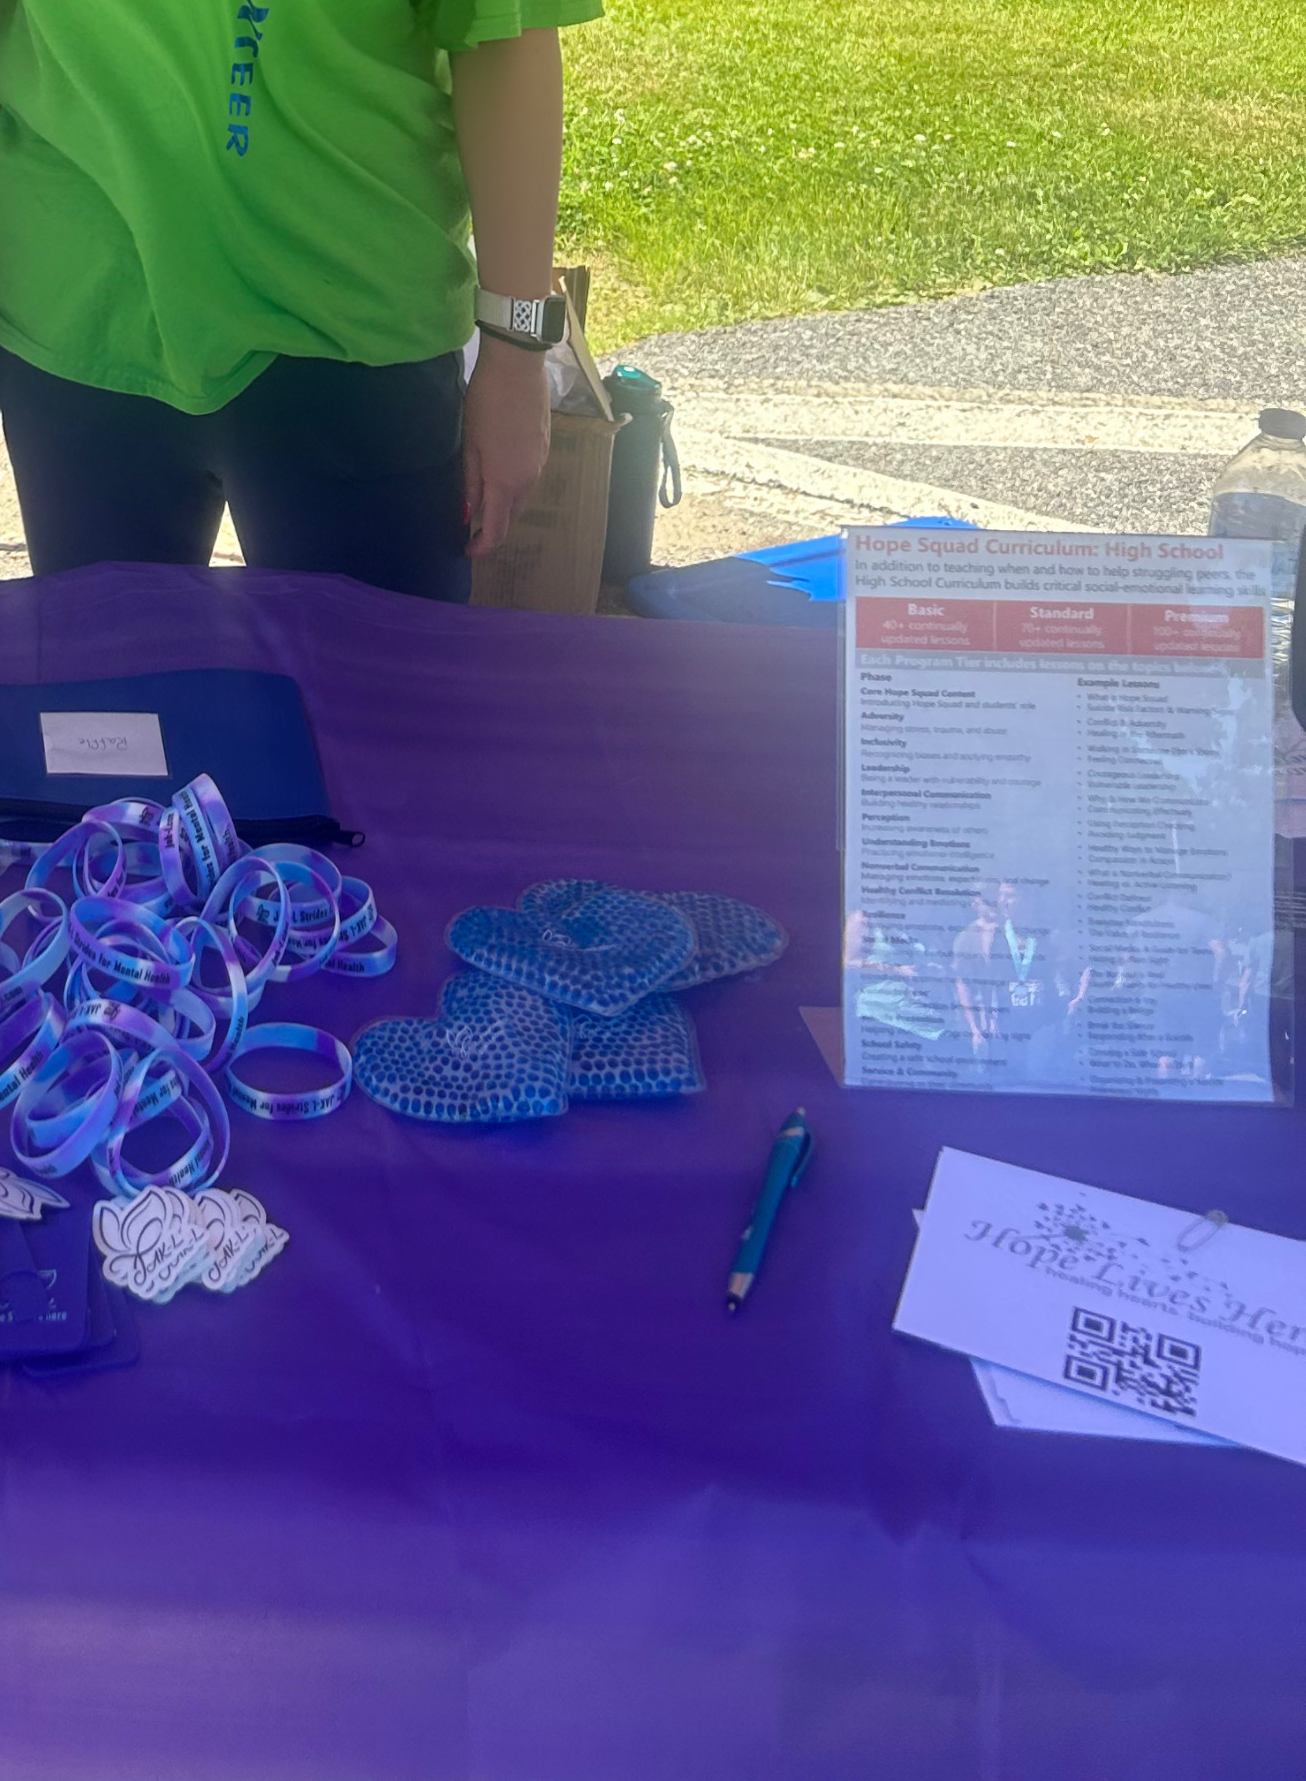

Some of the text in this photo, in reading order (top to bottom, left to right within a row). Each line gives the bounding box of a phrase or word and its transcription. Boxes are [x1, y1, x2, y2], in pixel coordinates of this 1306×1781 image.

[854, 534, 1224, 562] Hope Squad Curriculum: High School
[854, 560, 867, 570] In
[871, 561, 924, 573] addition
[927, 563, 940, 573] to
[943, 563, 994, 576] teaching
[997, 564, 1030, 574] when
[1033, 564, 1056, 576] and
[1059, 565, 1084, 577] how
[1087, 566, 1100, 576] to
[1103, 566, 1130, 578] help
[1133, 568, 1193, 581] struggling
[1235, 570, 1256, 580] the
[854, 575, 886, 589] High
[890, 576, 932, 588] School
[935, 577, 1002, 590] Curriculum
[1004, 578, 1039, 591] builds
[1042, 580, 1082, 591] critical
[1085, 582, 1183, 594] social-emotional
[1186, 584, 1234, 598] learning
[907, 603, 944, 616] Basic
[1030, 606, 1094, 620] Standard
[1164, 610, 1230, 623] Premium
[895, 656, 953, 668] Program
[860, 673, 892, 682] Phase
[860, 687, 975, 698] Core Hope Squad Content
[861, 712, 904, 722] Adversity
[861, 738, 907, 748] Inclusivity
[861, 764, 910, 773] Leadership
[113, 960, 143, 980] Mental
[144, 970, 171, 985] Health
[963, 1219, 1212, 1313] Hope Lives
